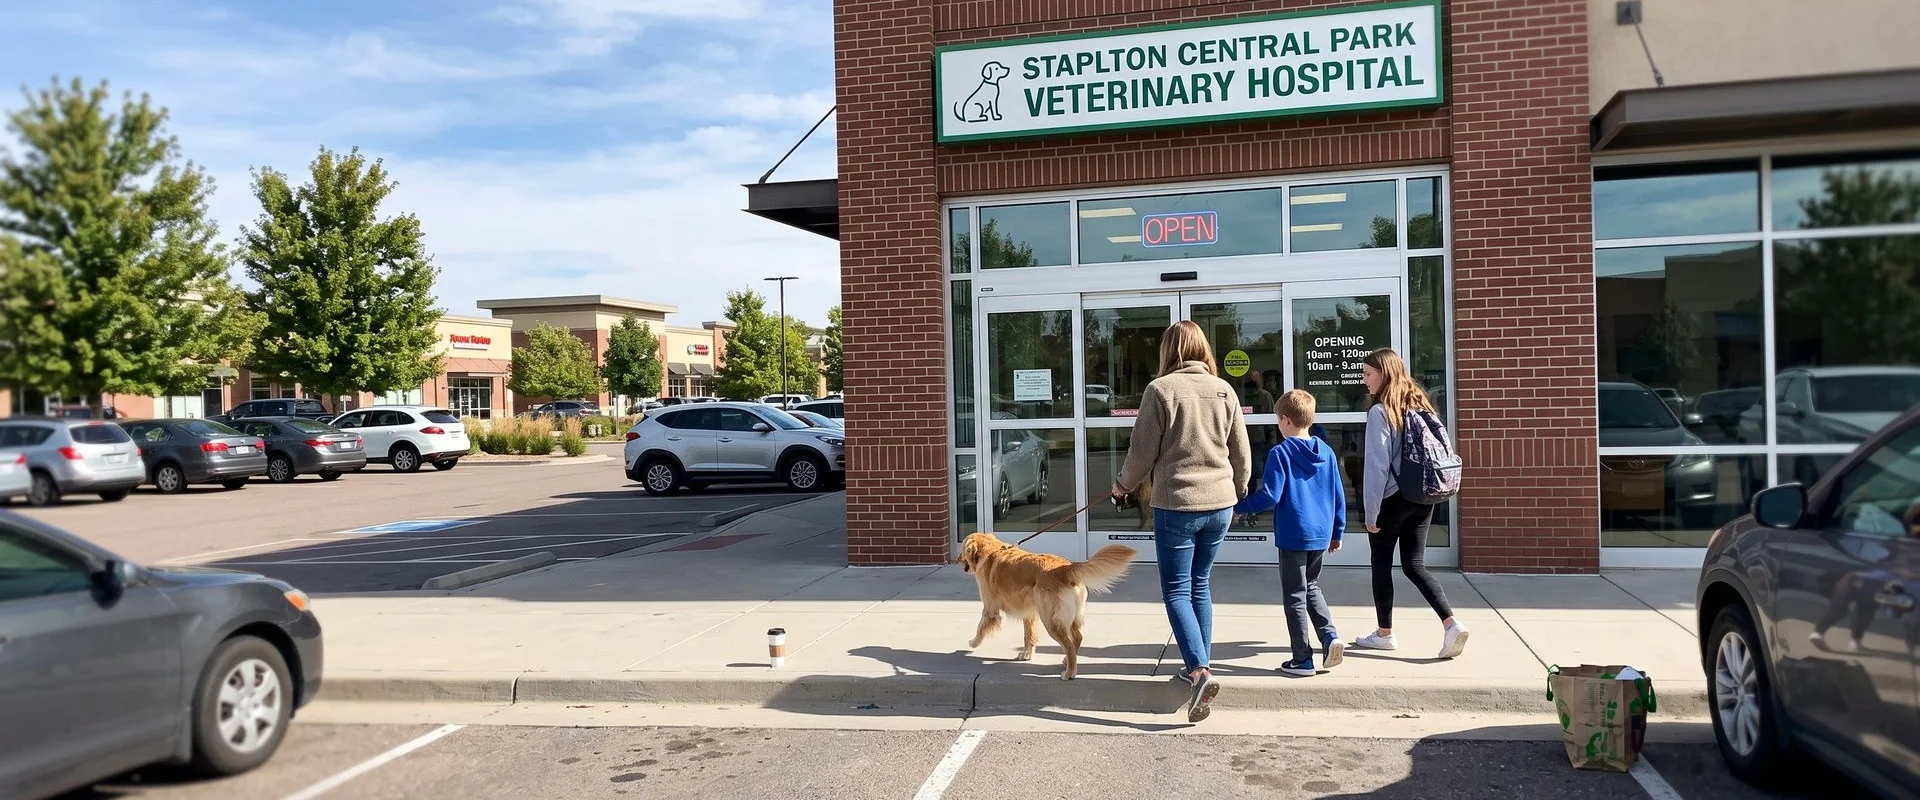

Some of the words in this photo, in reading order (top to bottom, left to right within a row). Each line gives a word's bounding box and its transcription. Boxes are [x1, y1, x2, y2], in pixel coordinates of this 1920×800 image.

[1022, 44, 1167, 80] STAPLTON
[1178, 31, 1320, 66] CENTRAL
[1330, 21, 1416, 52] PARK
[1023, 70, 1236, 117] VETERINARY
[1248, 54, 1424, 99] HOSPITAL
[1145, 214, 1214, 244] OPEN
[1314, 336, 1365, 347] OPENING
[1306, 350, 1332, 359] 10am
[1307, 361, 1333, 371] 10am
